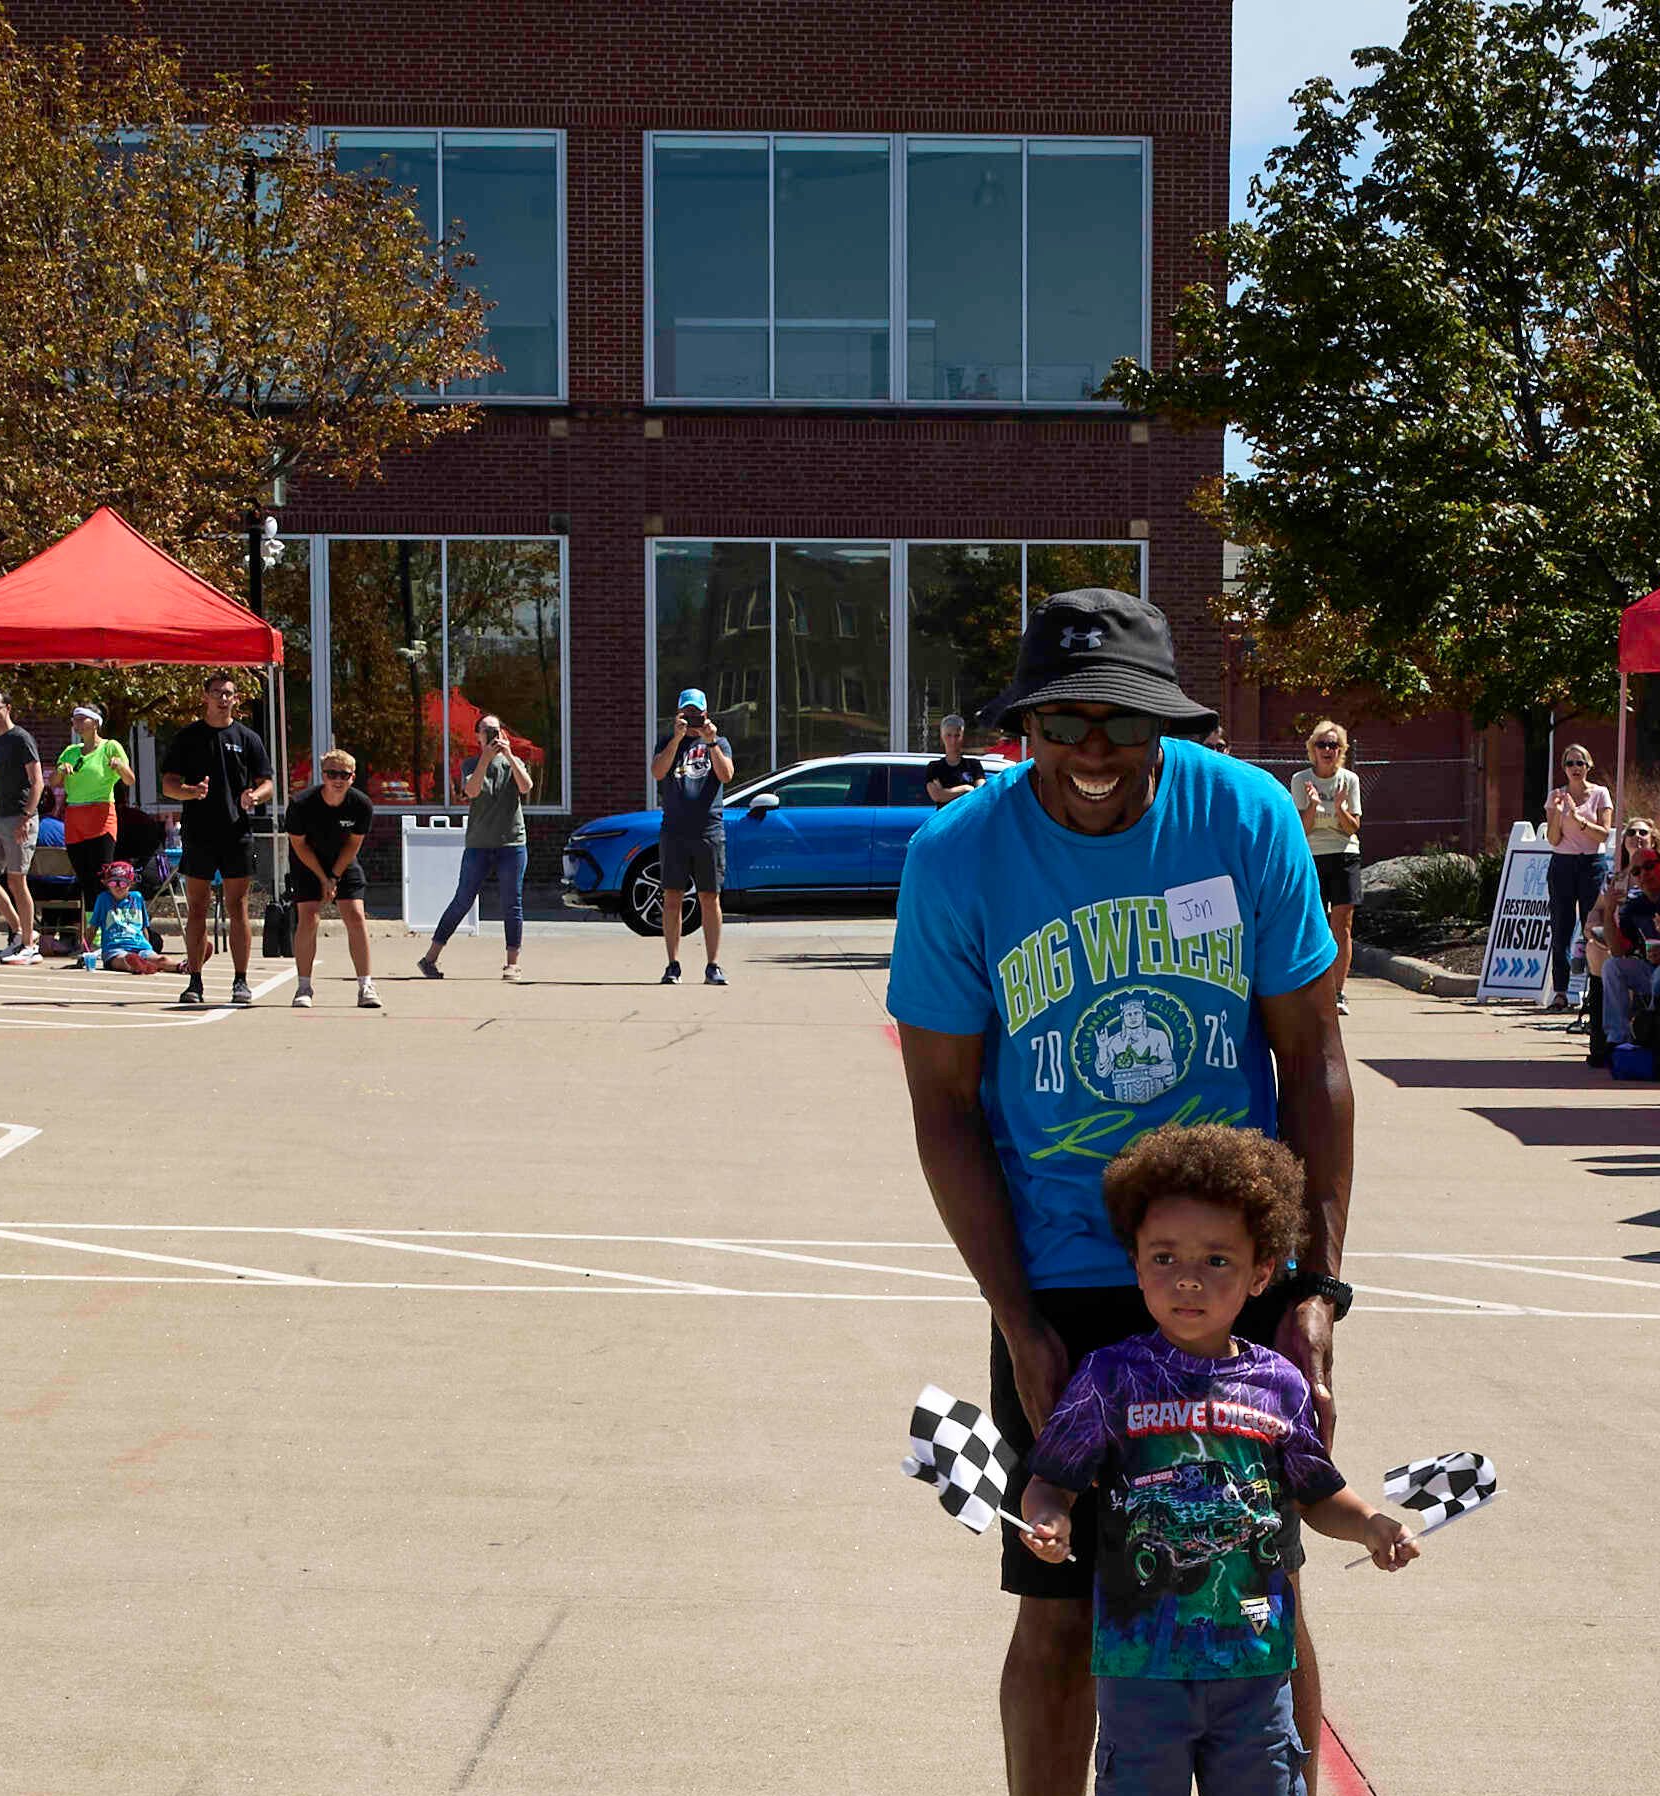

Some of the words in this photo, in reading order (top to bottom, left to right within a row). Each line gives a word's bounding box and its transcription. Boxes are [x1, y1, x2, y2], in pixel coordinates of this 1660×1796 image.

[1177, 898, 1213, 922] Jon
[1497, 919, 1553, 951] INSIDE
[998, 918, 1075, 1037] BIG
[1031, 1030, 1065, 1094] 20
[1205, 1009, 1237, 1069] 26
[1126, 1401, 1207, 1433] GRAVE
